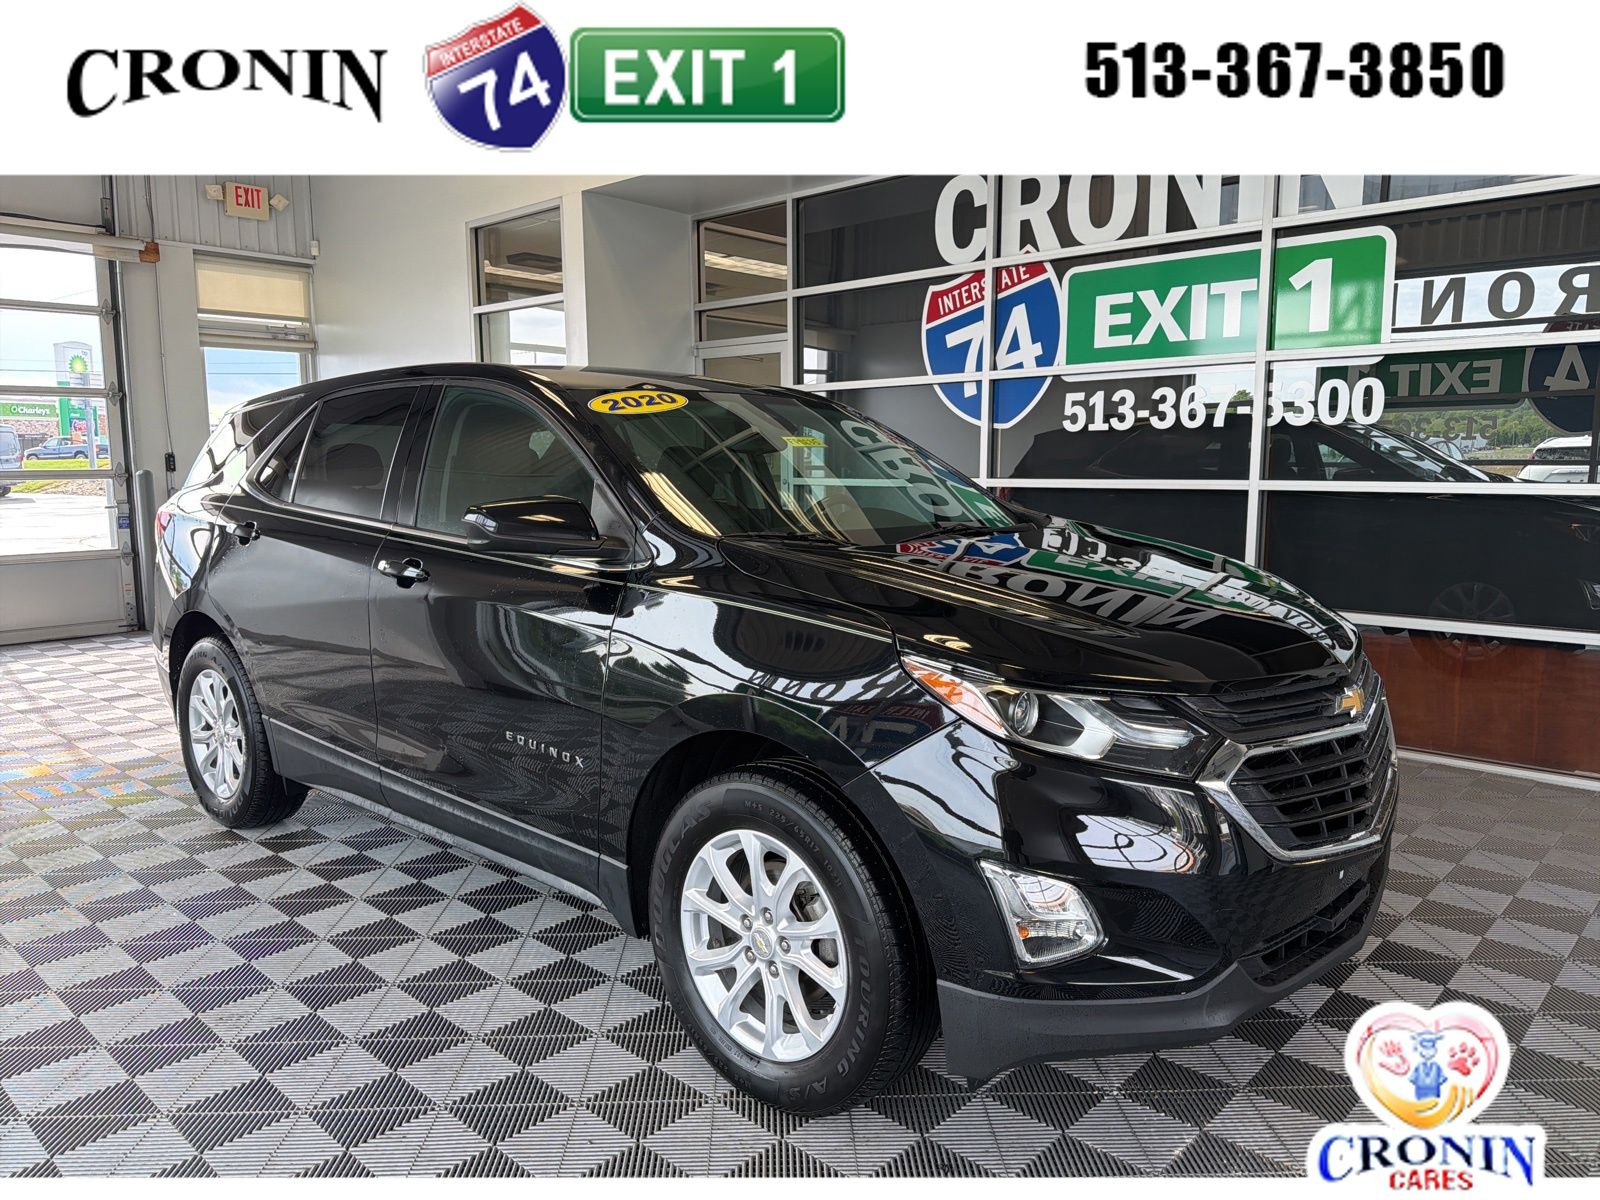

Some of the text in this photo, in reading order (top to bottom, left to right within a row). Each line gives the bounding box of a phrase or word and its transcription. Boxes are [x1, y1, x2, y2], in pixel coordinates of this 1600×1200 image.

[234, 185, 262, 210] EXIT
[934, 174, 1363, 265] CRONIN
[1094, 257, 1333, 349] EXIT 1
[945, 302, 1043, 398] 74
[601, 393, 678, 412] 2020
[505, 730, 584, 769] EQUINOX
[654, 801, 712, 950] DOUGLAS
[836, 933, 871, 1078] TOURING
